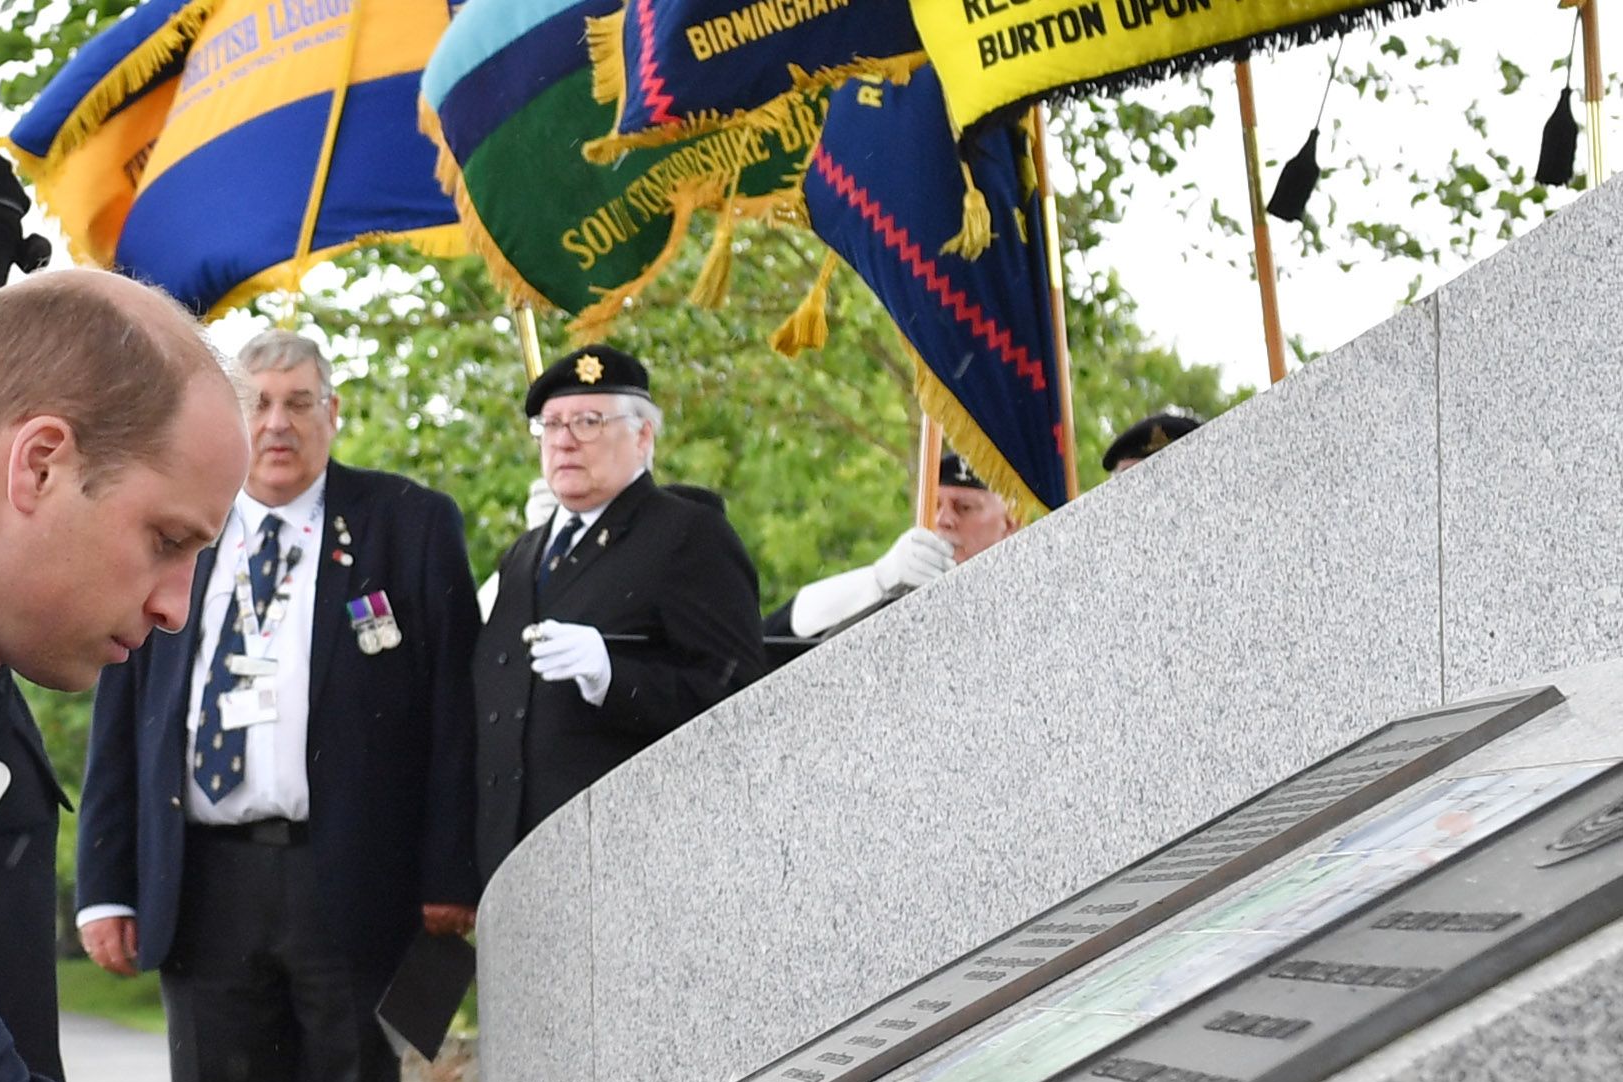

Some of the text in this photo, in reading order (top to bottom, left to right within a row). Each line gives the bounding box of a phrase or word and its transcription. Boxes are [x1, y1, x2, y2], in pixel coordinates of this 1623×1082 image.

[292, 22, 348, 53] BRANC
[685, 0, 849, 62] BIRMINGHA
[977, 2, 1108, 69] BURTON
[777, 96, 830, 154] BR
